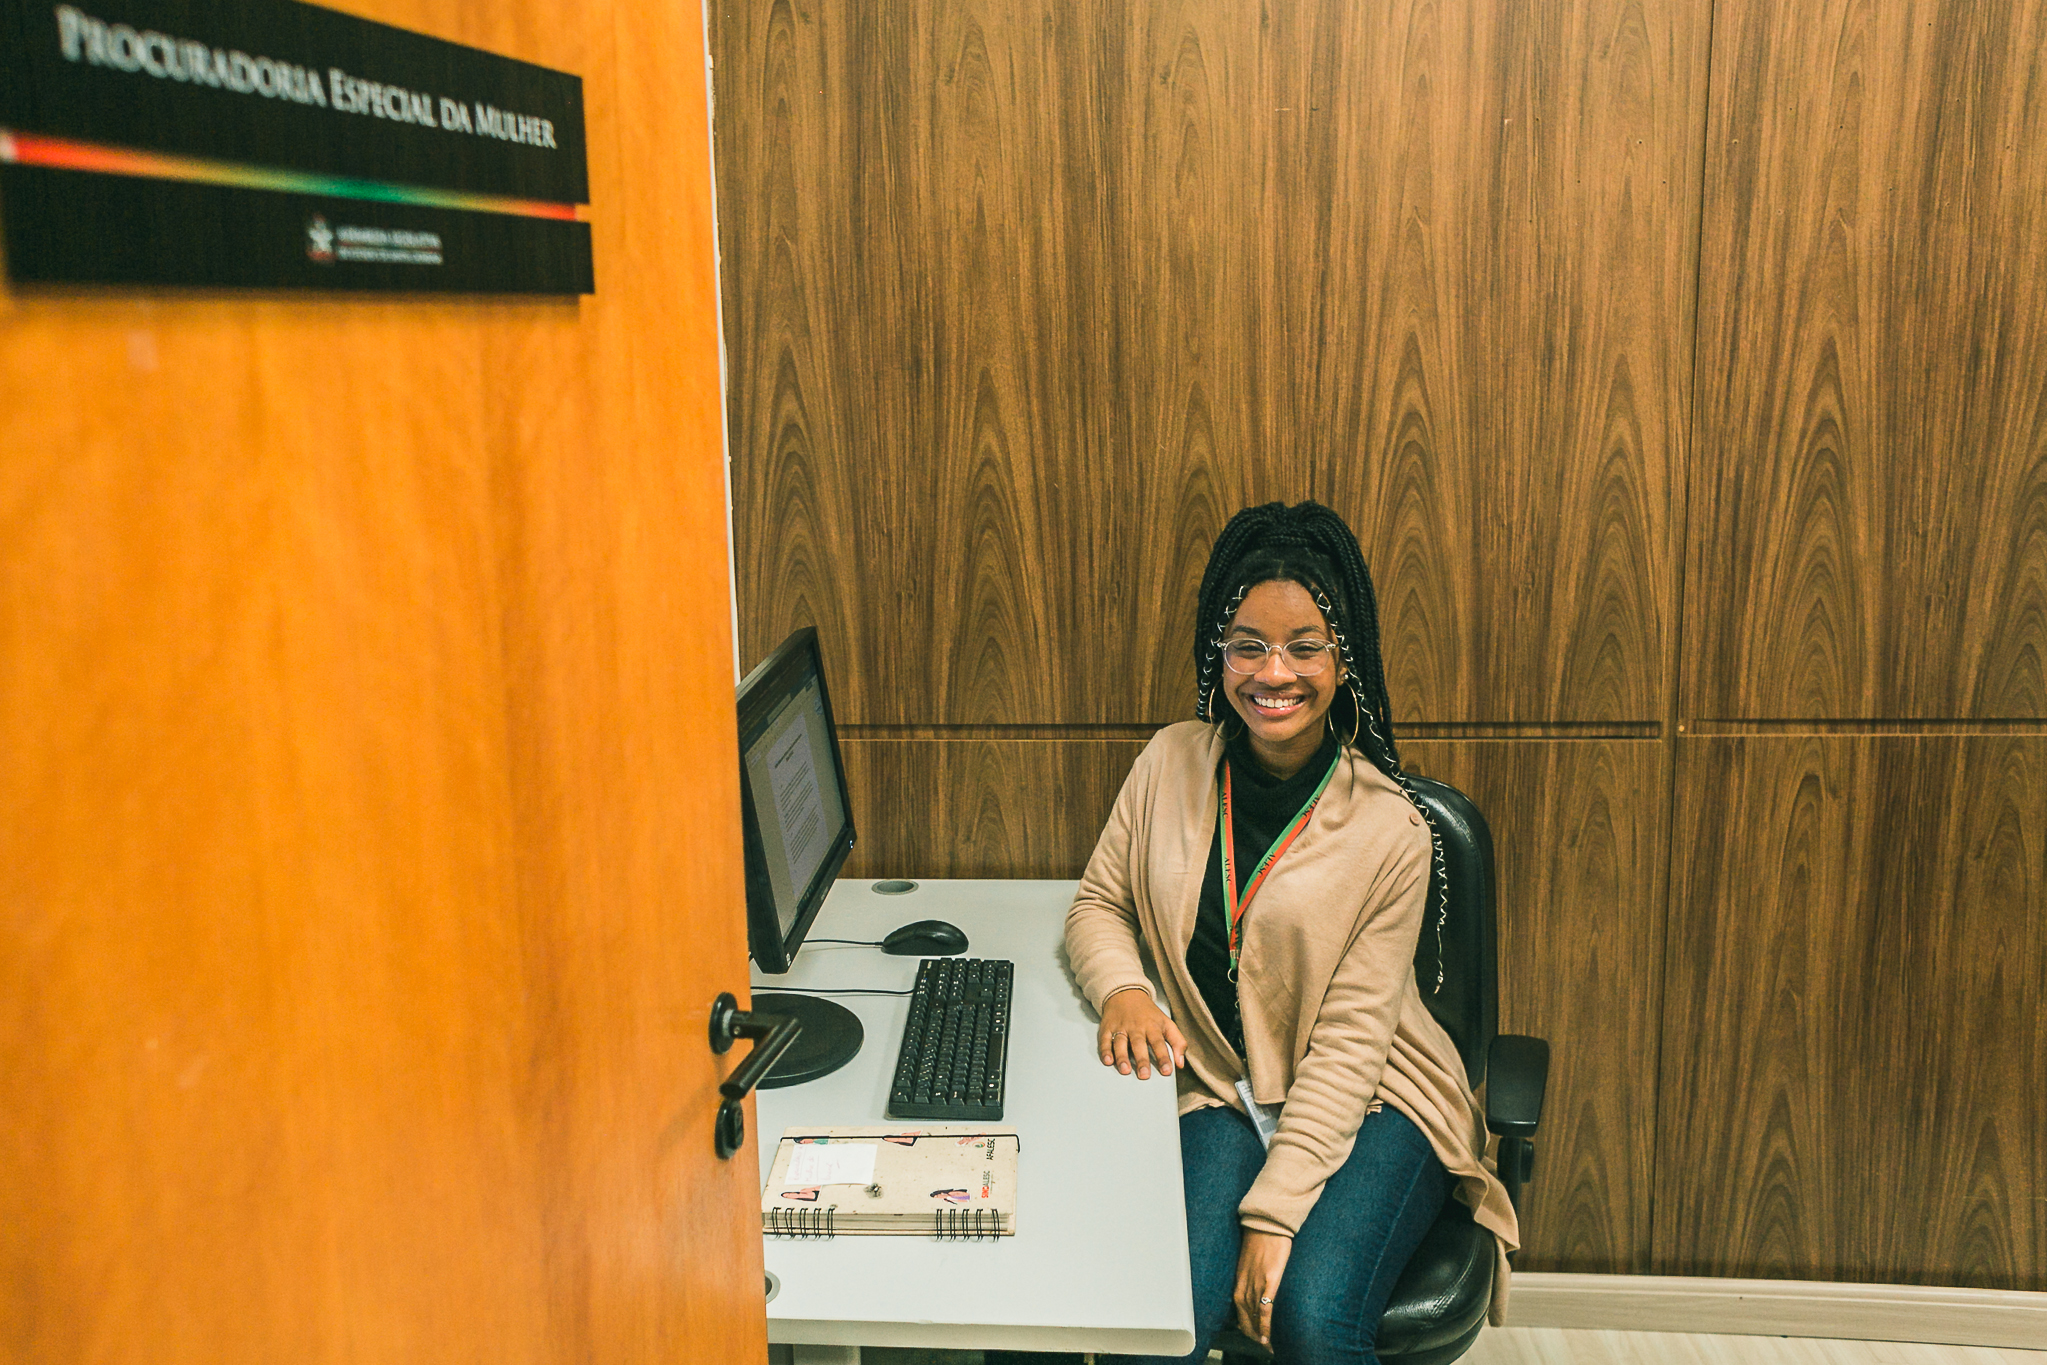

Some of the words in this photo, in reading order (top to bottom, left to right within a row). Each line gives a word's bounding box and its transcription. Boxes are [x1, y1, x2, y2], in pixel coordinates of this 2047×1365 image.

[57, 5, 324, 107] PROCURADORIA
[330, 68, 436, 128] ESPECIAL
[476, 100, 557, 149] MULHER
[1224, 857, 1232, 883] ALESC
